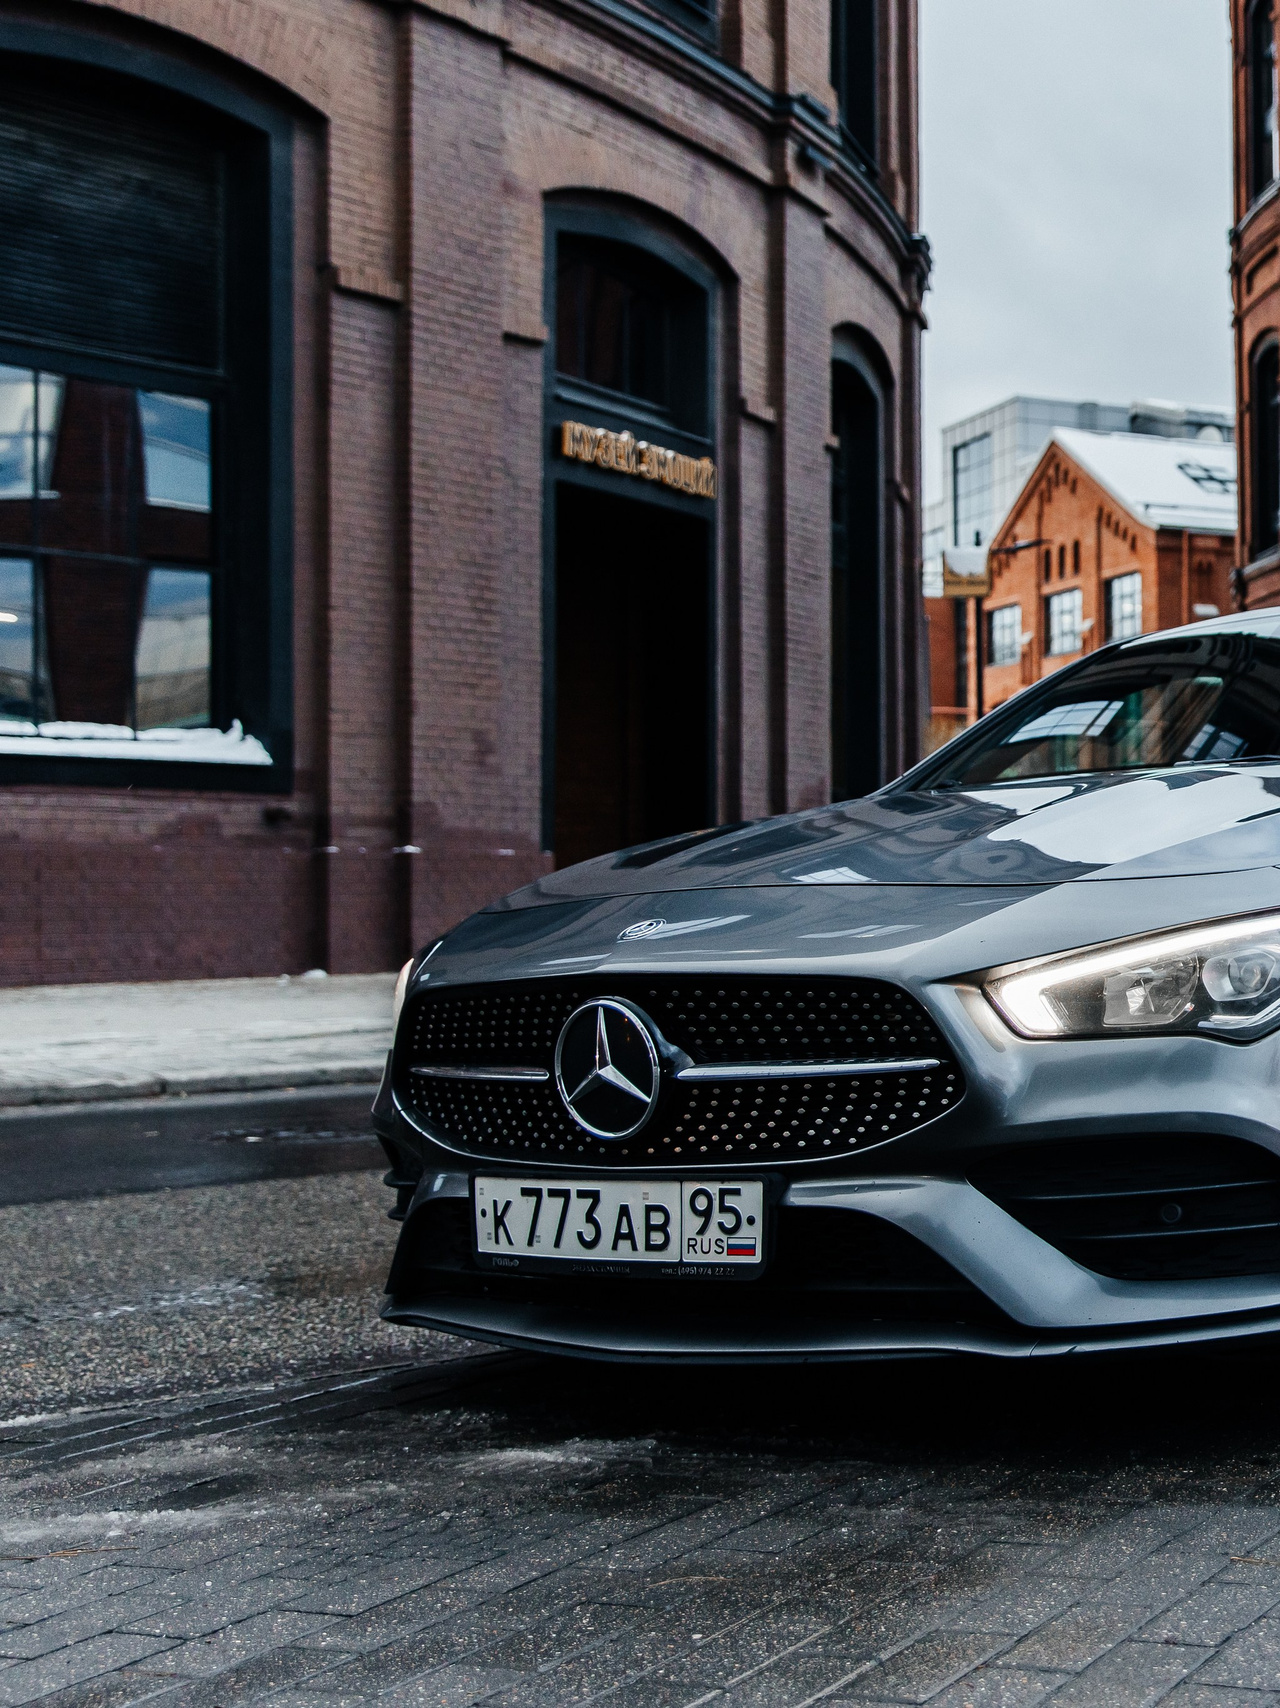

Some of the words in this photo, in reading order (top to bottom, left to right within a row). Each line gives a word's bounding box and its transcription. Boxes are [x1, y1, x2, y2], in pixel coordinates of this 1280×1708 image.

[689, 1186, 743, 1236] 95
[687, 1237, 725, 1255] RUS
[678, 1266, 697, 1276] (495)
